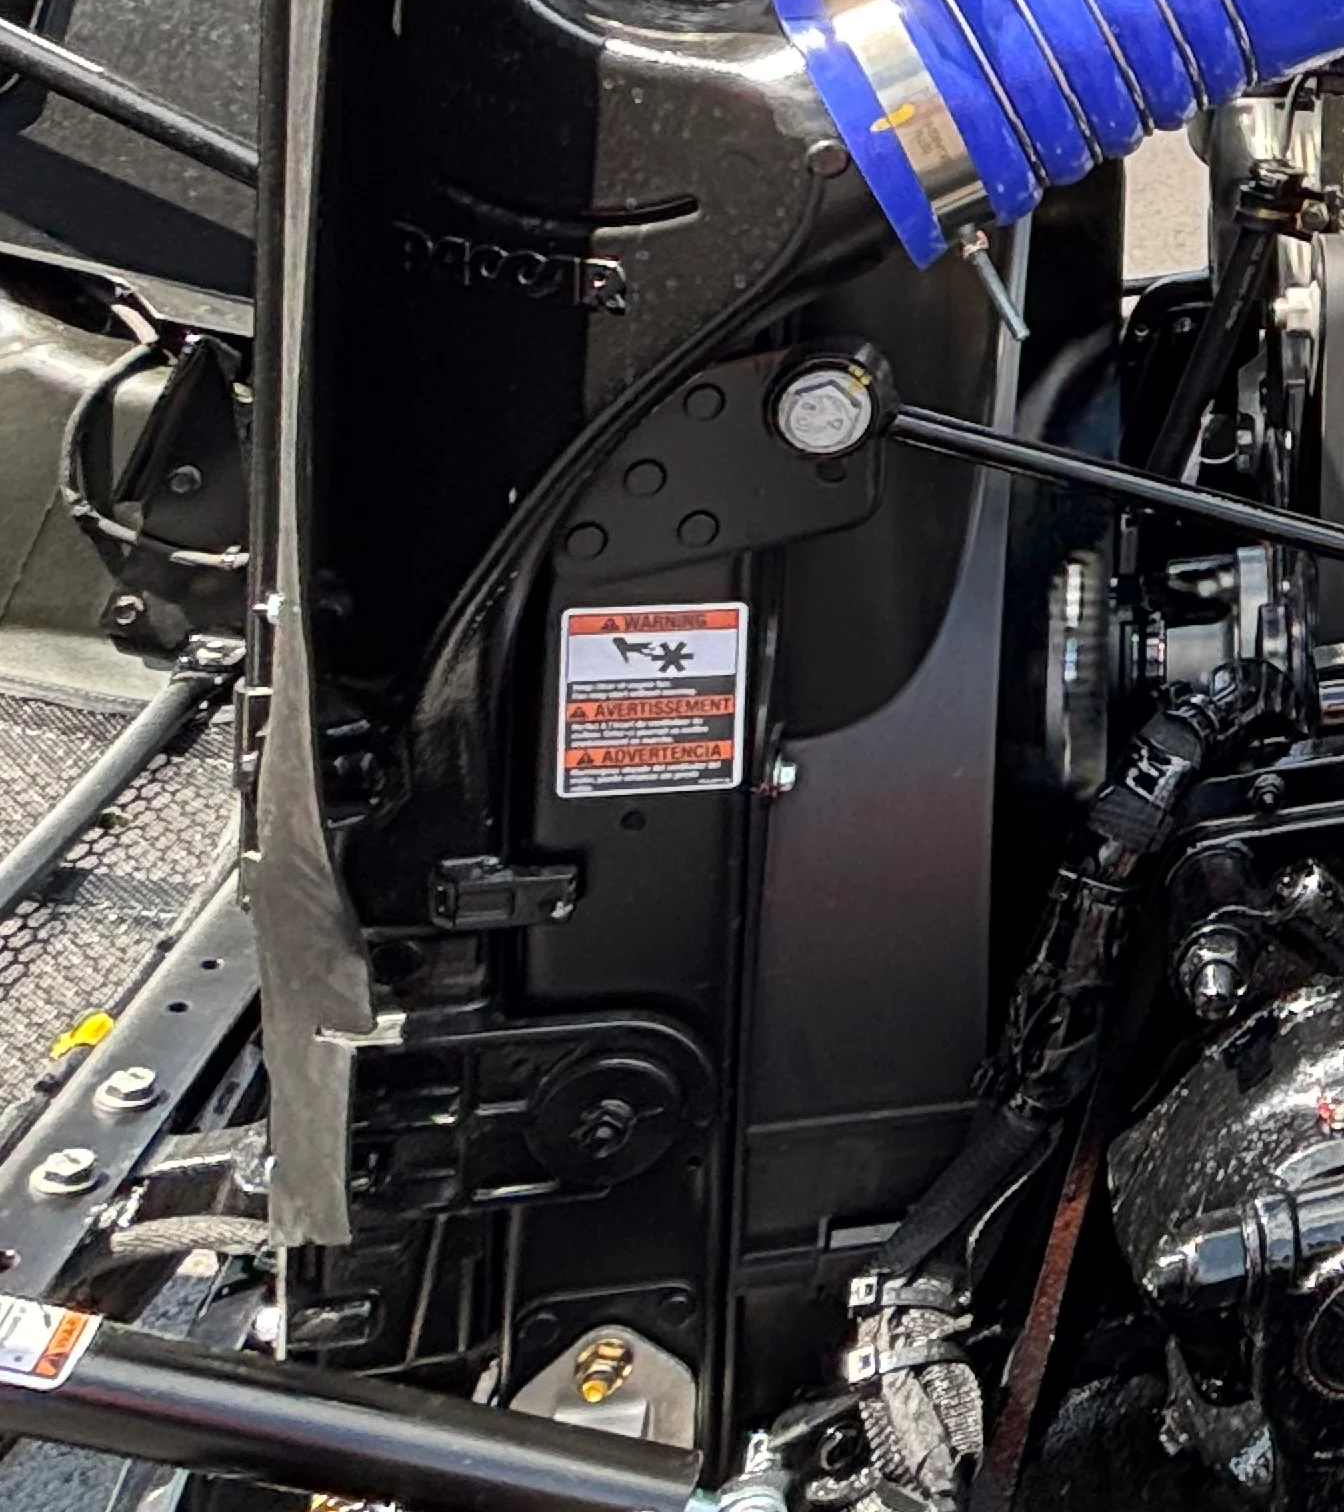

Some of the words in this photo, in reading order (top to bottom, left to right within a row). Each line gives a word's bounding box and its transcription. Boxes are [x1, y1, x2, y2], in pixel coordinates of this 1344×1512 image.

[624, 613, 708, 632] WARNING
[594, 697, 733, 719] AVERTISSEMENT
[601, 744, 722, 764] ADVERTENCIA
